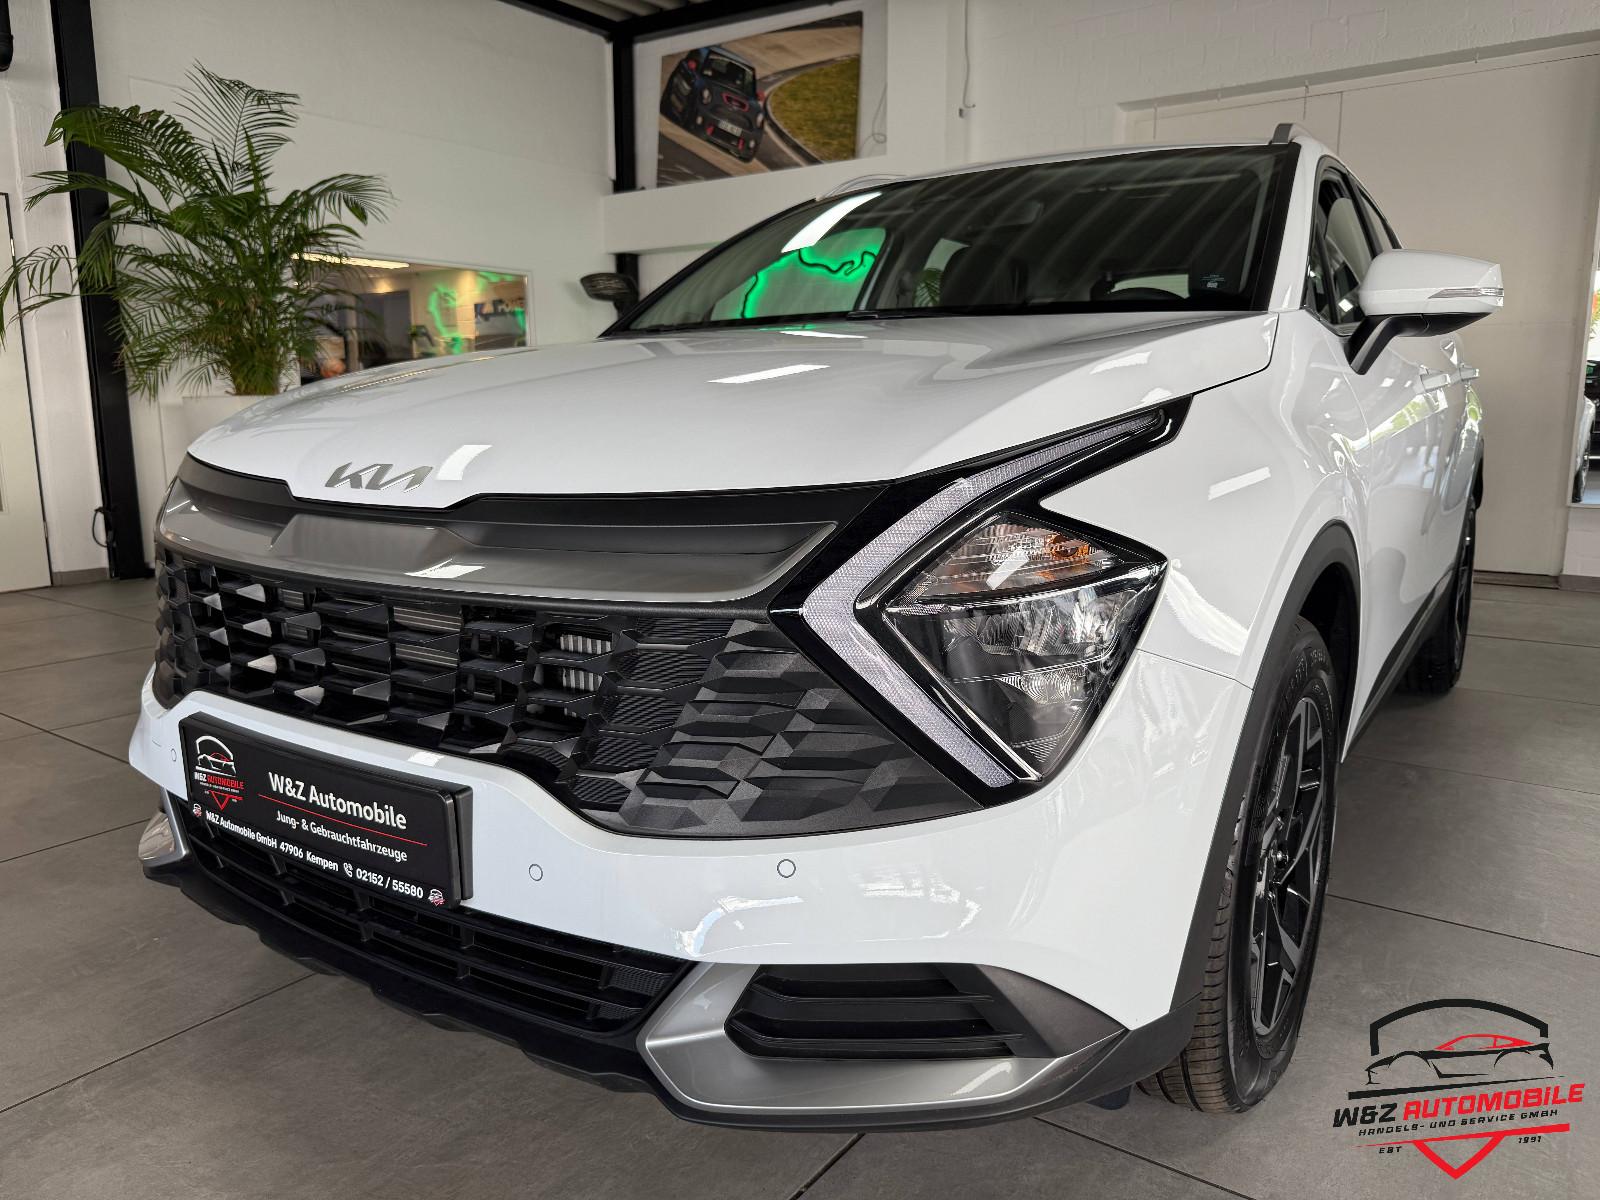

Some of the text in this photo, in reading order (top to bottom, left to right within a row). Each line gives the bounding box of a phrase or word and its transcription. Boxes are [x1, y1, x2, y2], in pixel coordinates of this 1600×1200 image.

[268, 771, 407, 830] W&Z Automobile
[205, 810, 220, 825] W&Z
[219, 817, 256, 840] Automobile
[256, 832, 278, 849] GmbH
[279, 841, 304, 859] 47906
[306, 850, 339, 872] Kempen
[356, 868, 384, 887] 02152
[392, 879, 424, 899] 55580
[276, 810, 408, 863] Jung- & Gebrauchtfahrzeuge
